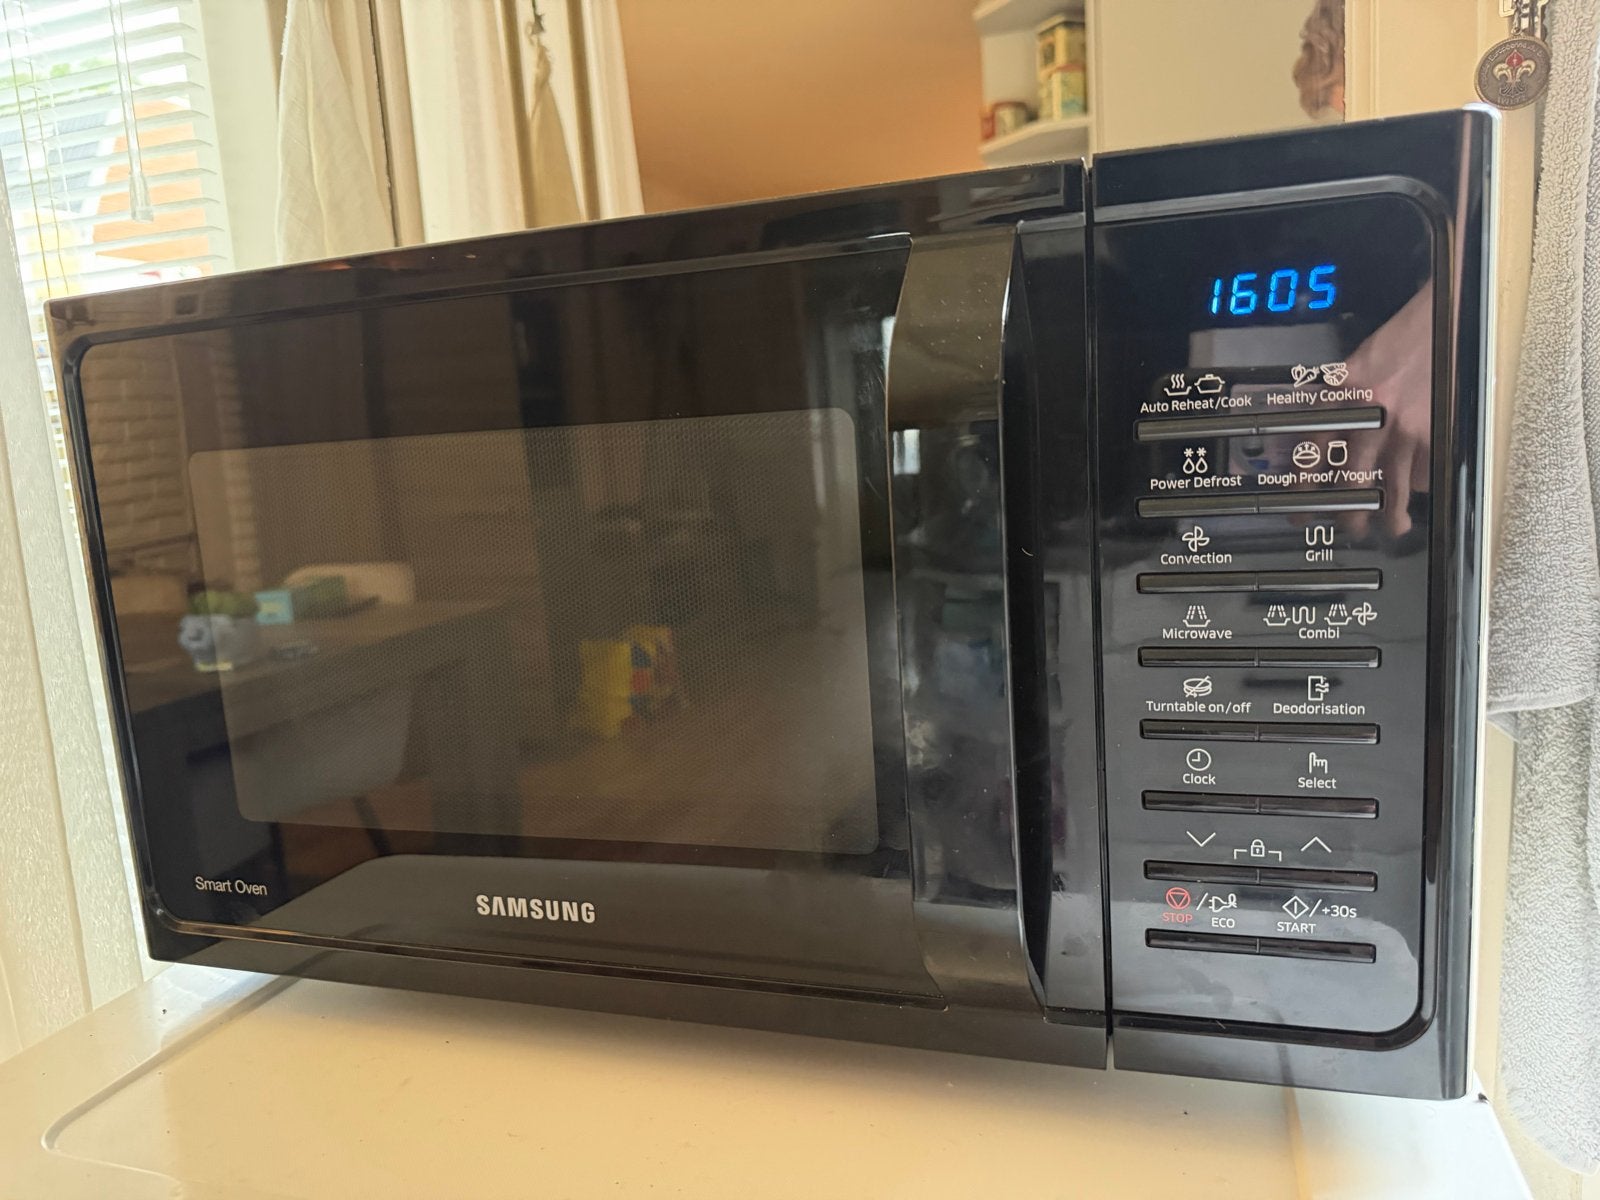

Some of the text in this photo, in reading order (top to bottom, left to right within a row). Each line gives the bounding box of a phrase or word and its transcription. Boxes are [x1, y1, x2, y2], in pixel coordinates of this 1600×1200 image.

[1211, 264, 1336, 315] 1605
[1267, 388, 1373, 405] Healthy Cooking
[1140, 400, 1169, 414] Auto
[1150, 474, 1242, 490] Power Defrost
[1257, 472, 1297, 488] Dough
[1160, 552, 1232, 565] Convection
[1305, 549, 1333, 562] Grill
[1162, 628, 1232, 640] Microwave
[1298, 627, 1340, 639] Combi
[1146, 700, 1206, 713] Turntable
[1272, 702, 1366, 716] Deodorisation
[1182, 772, 1216, 786] Clock
[1297, 776, 1337, 790] Select
[195, 876, 268, 896] Smart Oven
[476, 894, 596, 924] SAMSUNG
[1162, 912, 1193, 924] STOP
[1211, 917, 1236, 929] ECO
[1276, 920, 1317, 935] START
